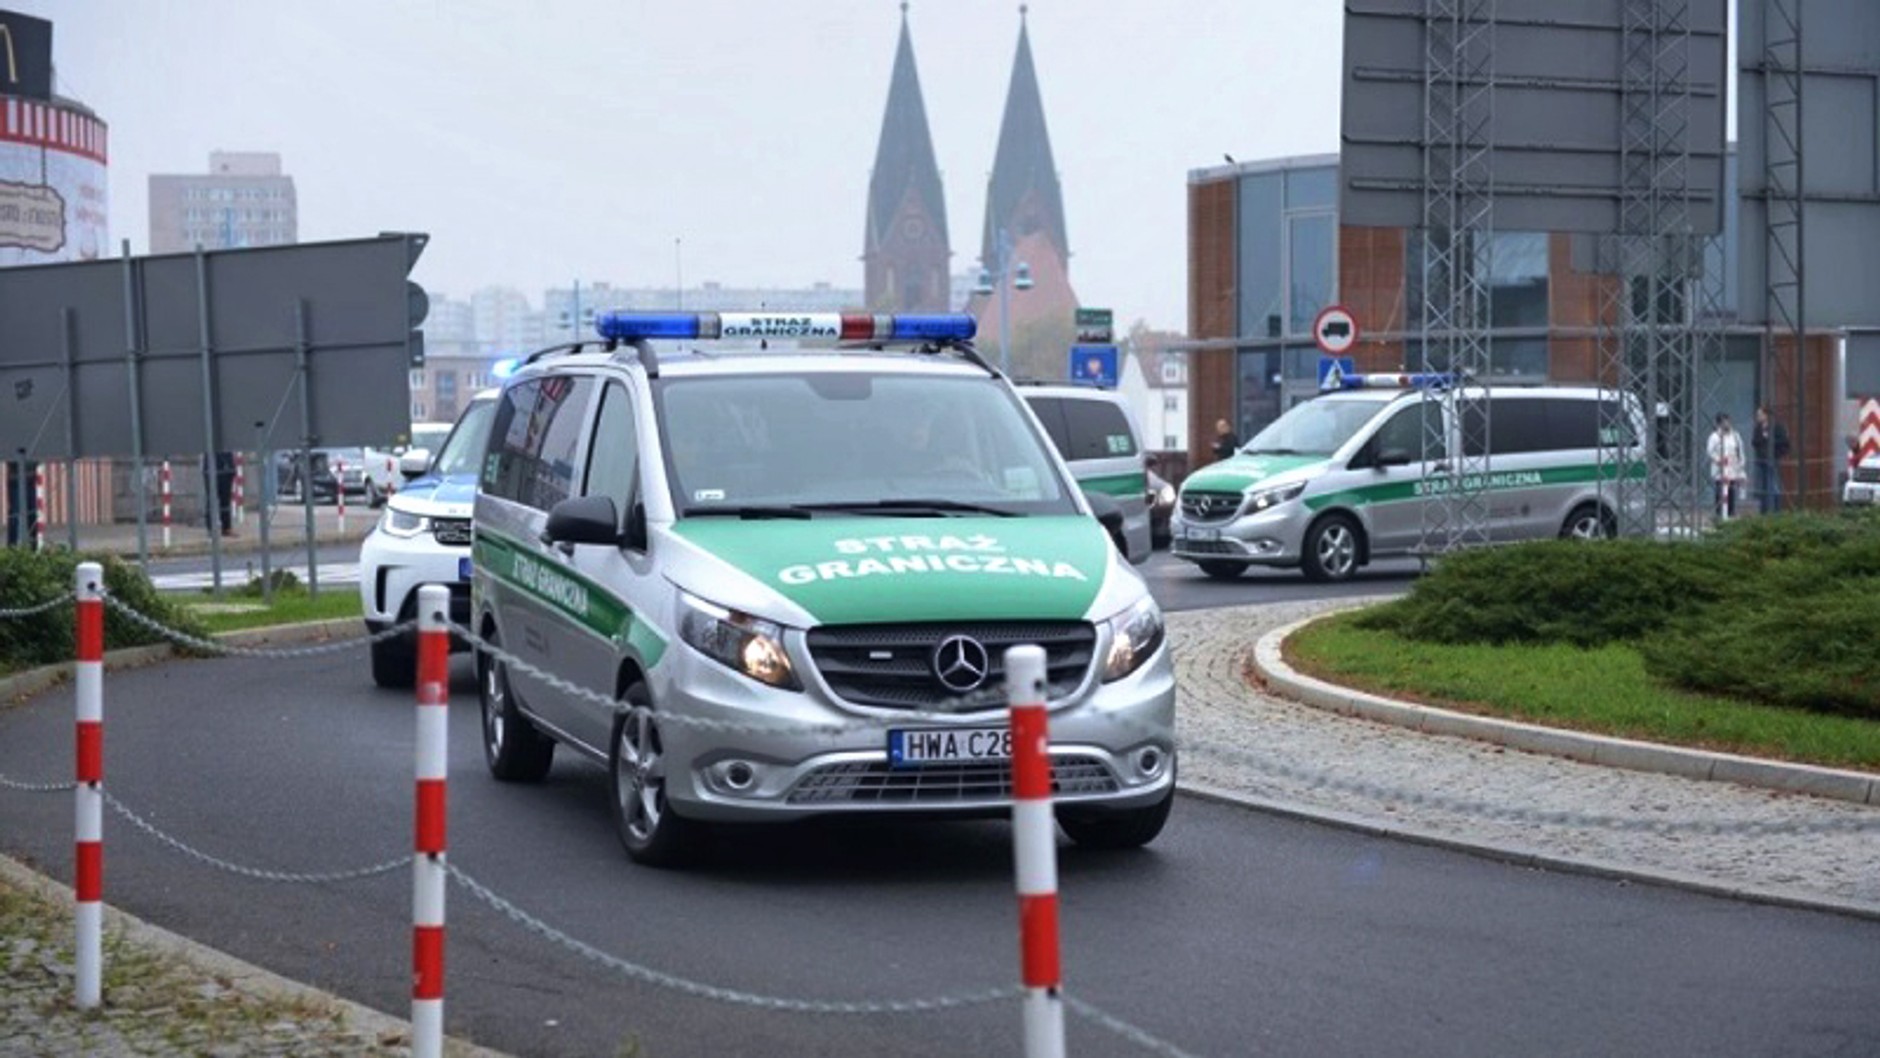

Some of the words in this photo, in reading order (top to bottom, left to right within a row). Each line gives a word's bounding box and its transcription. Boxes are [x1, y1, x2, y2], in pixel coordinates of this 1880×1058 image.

[723, 326, 837, 335] GRANICZNA
[778, 554, 1088, 584] GRANICZNA
[908, 733, 958, 758] HWA
